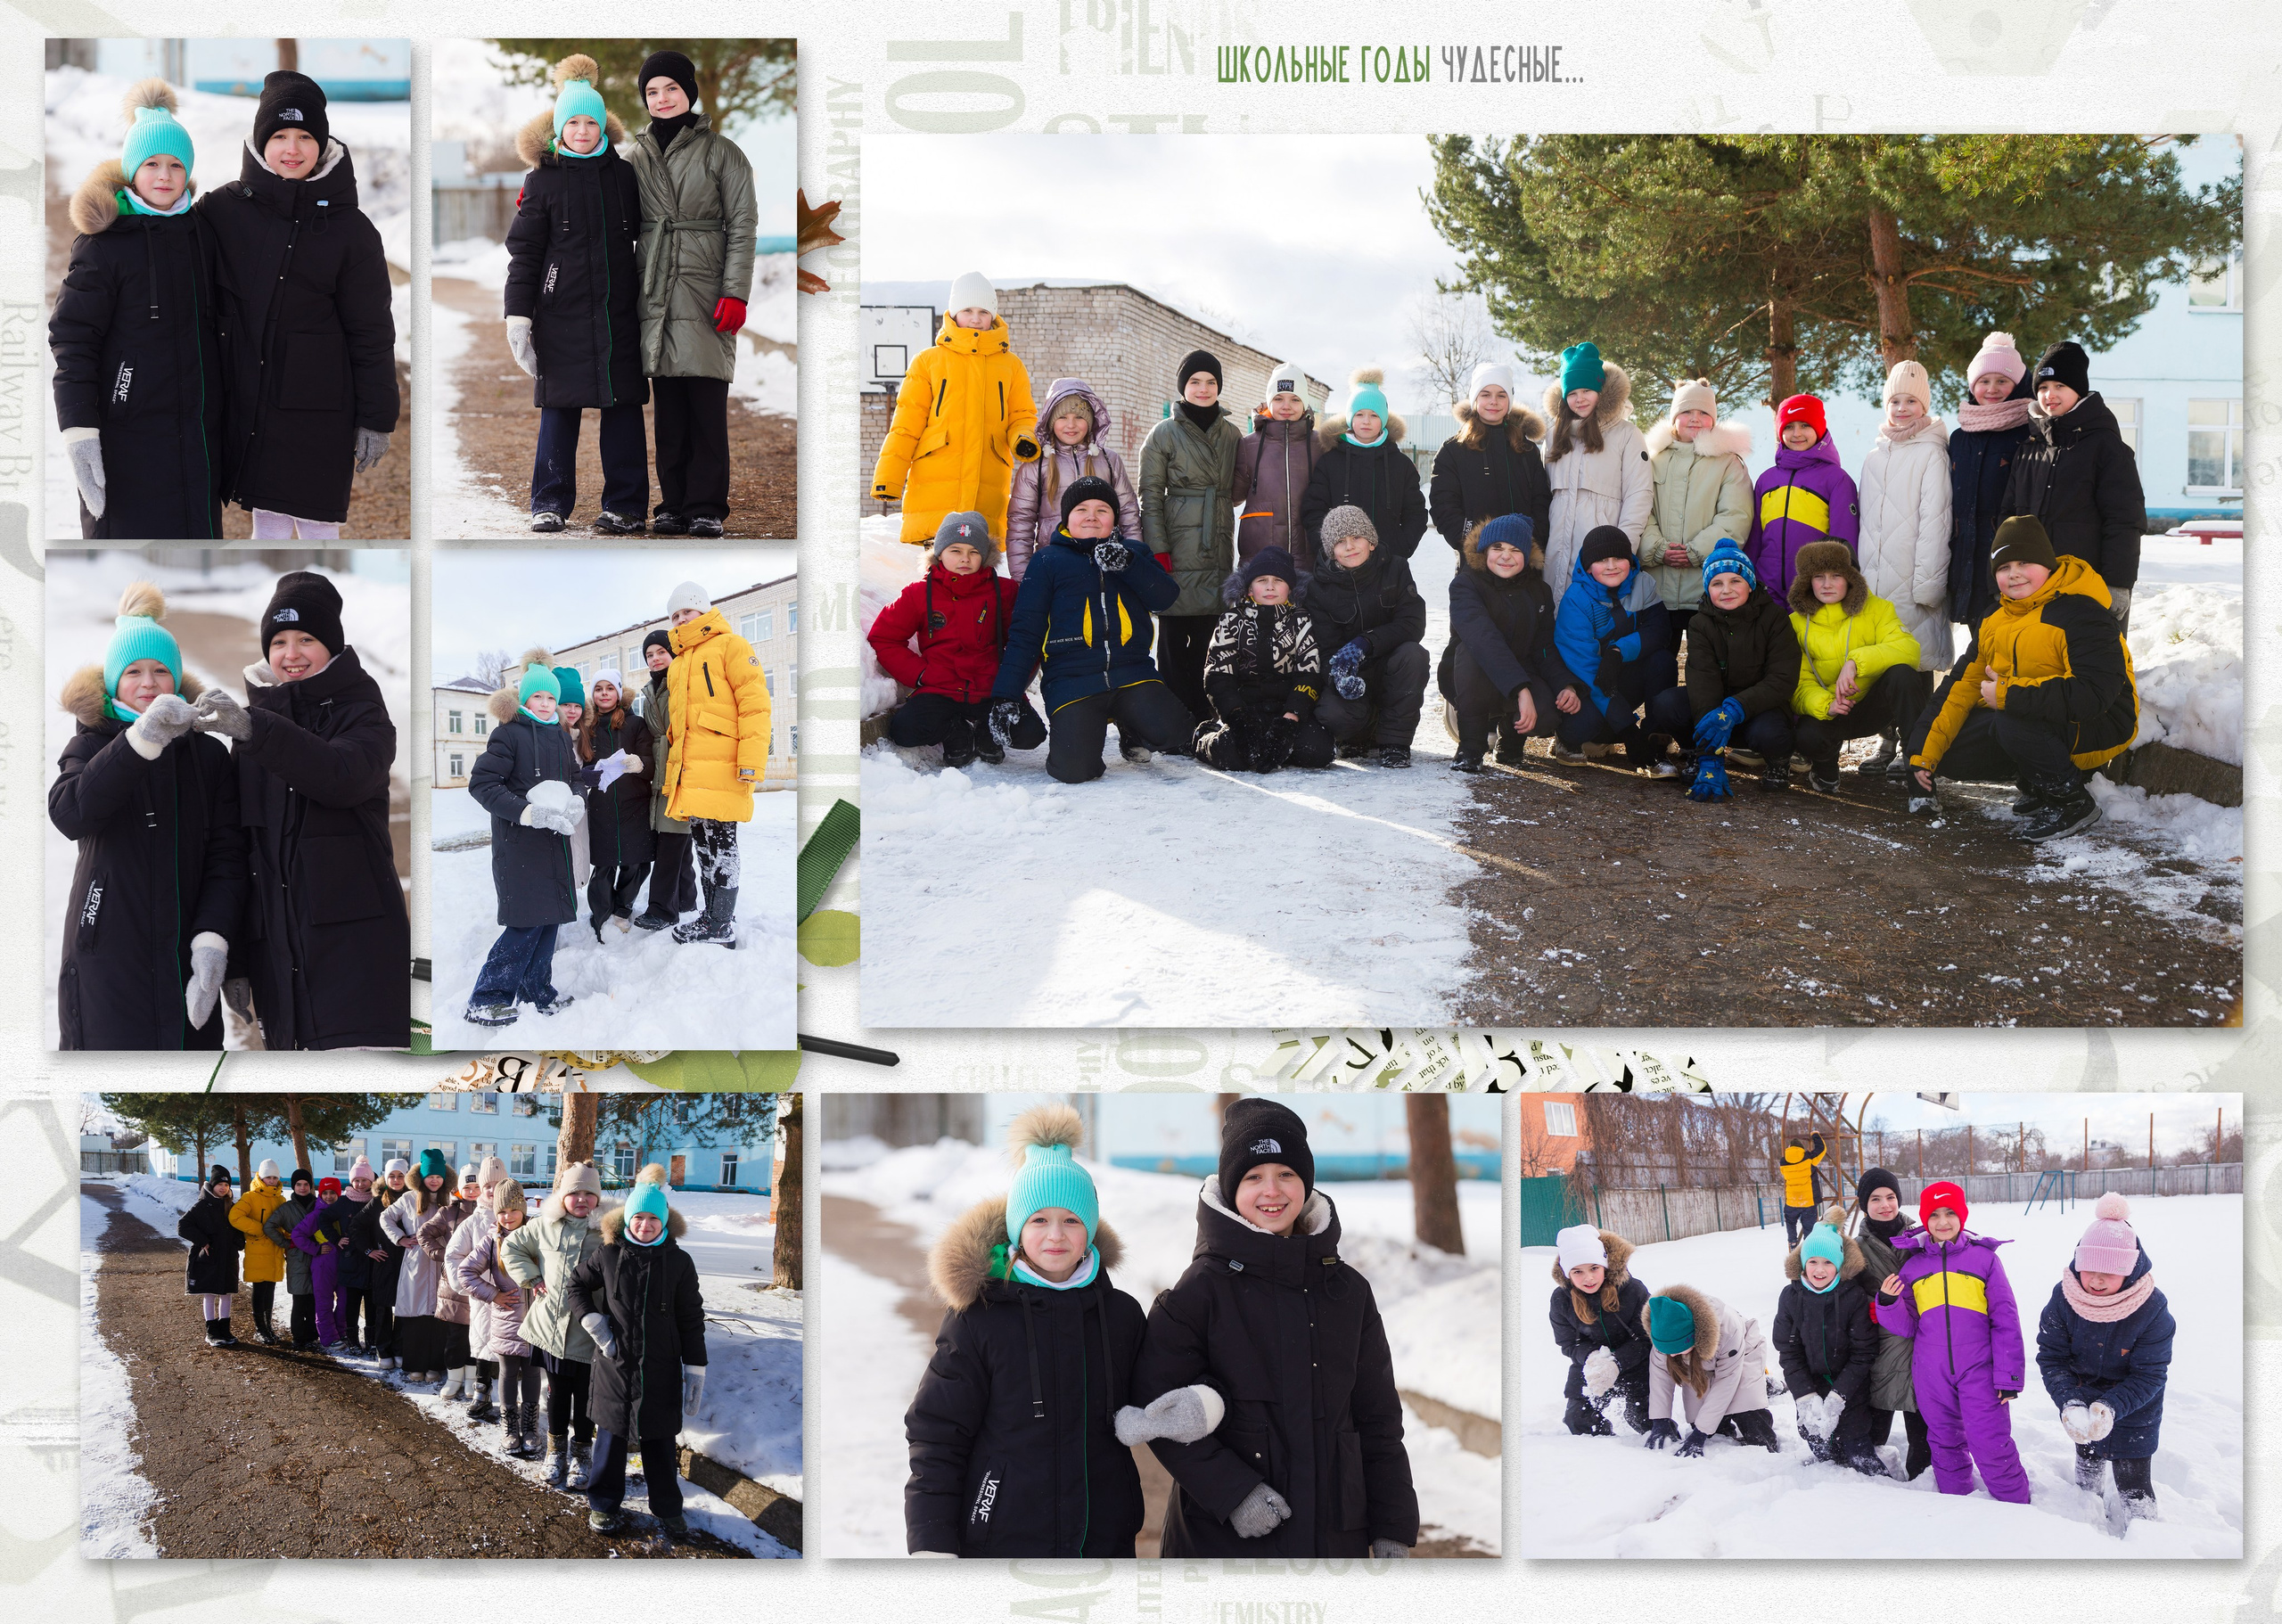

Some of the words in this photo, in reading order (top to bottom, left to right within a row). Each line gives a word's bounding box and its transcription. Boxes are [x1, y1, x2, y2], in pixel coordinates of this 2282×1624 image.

[547, 267, 559, 293] VERAF
[118, 367, 134, 402] VERAF
[86, 888, 103, 926] VERAF
[1250, 1143, 1270, 1152] NORTH
[978, 1480, 1000, 1523] VERAF
